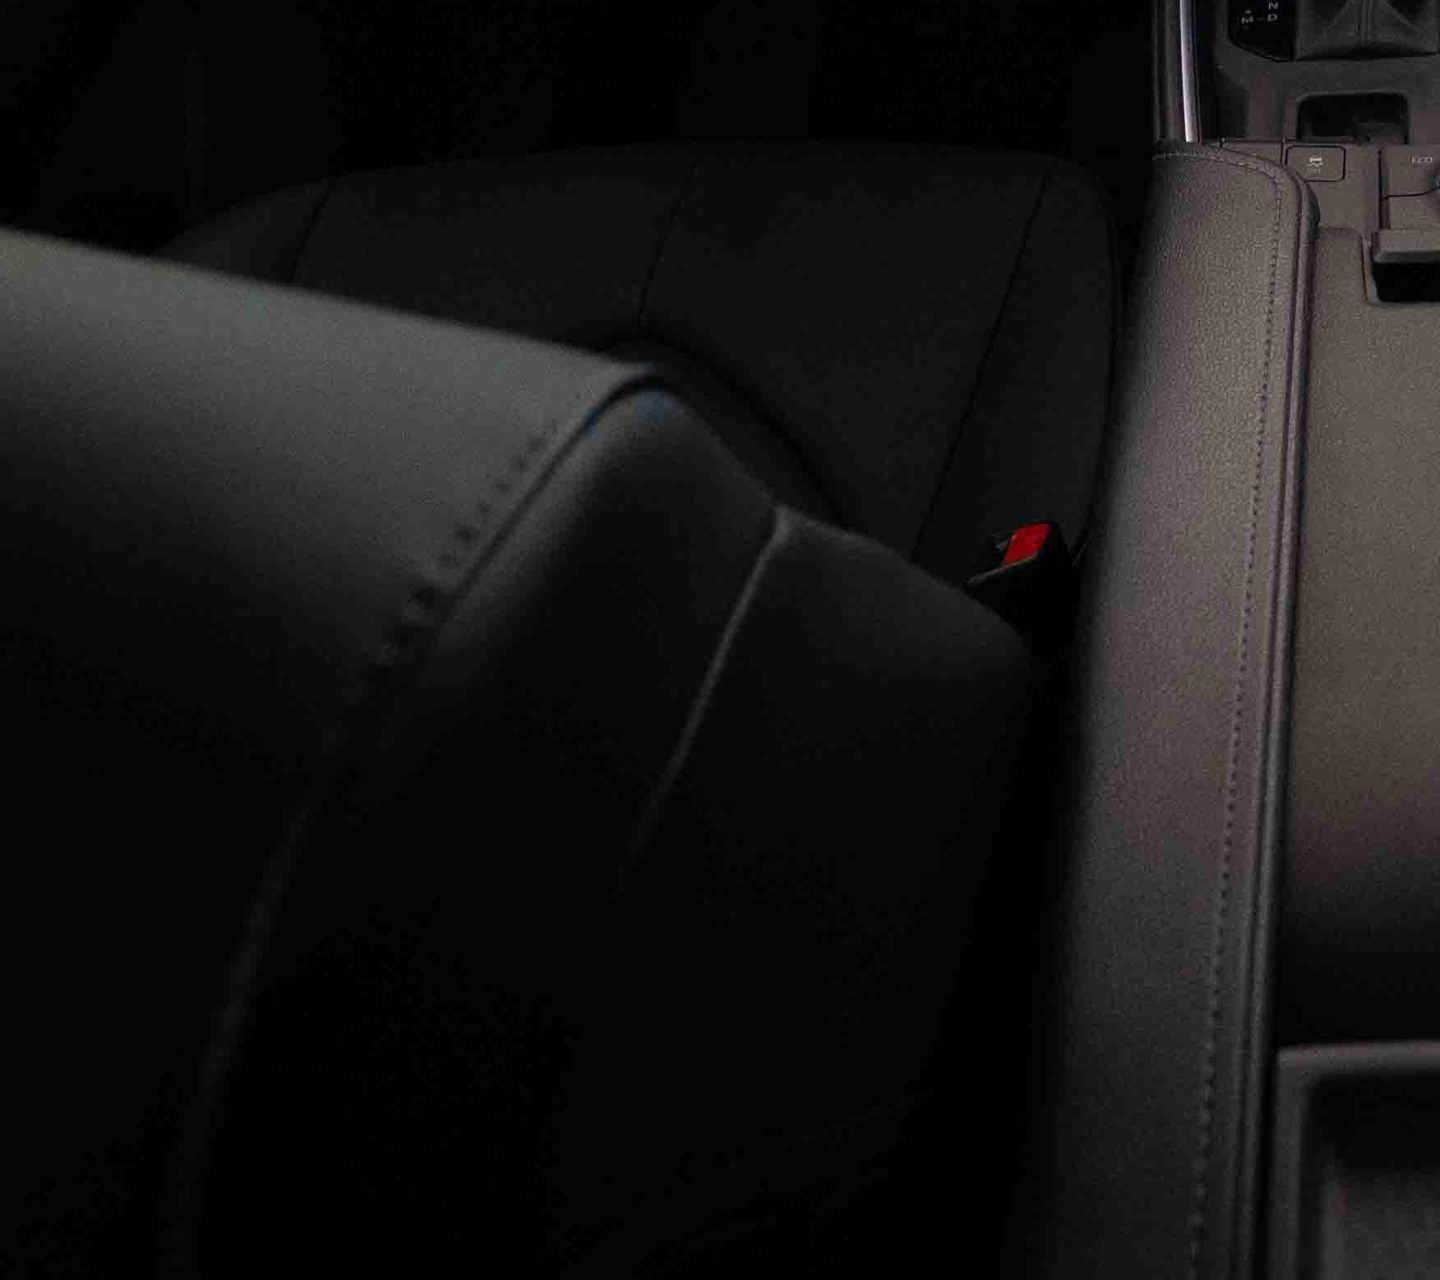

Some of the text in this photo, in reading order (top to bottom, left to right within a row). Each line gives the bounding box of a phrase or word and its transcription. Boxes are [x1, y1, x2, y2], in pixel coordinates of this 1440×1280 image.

[1268, 0, 1279, 11] N
[1240, 16, 1255, 26] M
[1266, 13, 1279, 24] D
